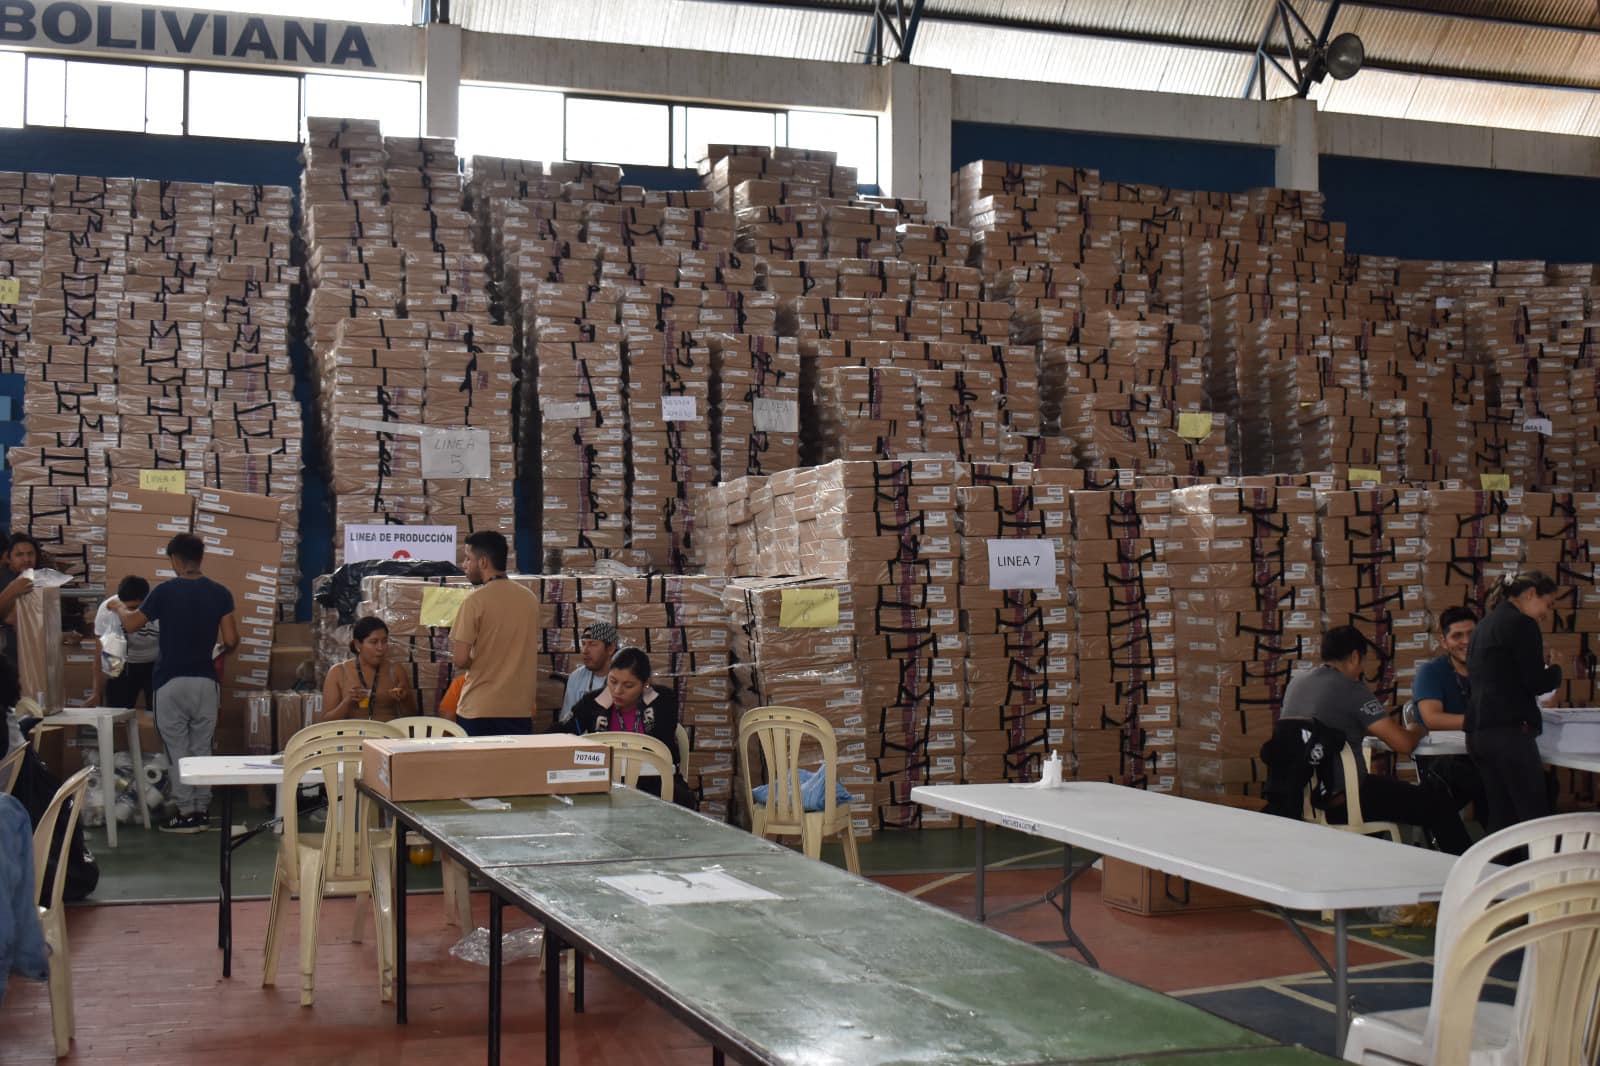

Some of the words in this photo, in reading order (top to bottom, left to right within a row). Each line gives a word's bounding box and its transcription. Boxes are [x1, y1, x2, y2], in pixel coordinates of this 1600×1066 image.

[0, 0, 376, 67] BOLIVIANA
[434, 438, 475, 450] LINEA
[450, 454, 465, 474] 5
[350, 532, 377, 542] LINEA
[379, 532, 391, 542] DE
[393, 531, 453, 543] PRODUCCIÓN
[997, 555, 1031, 567] LINEA
[1033, 555, 1041, 566] 7
[575, 753, 600, 762] 707446
